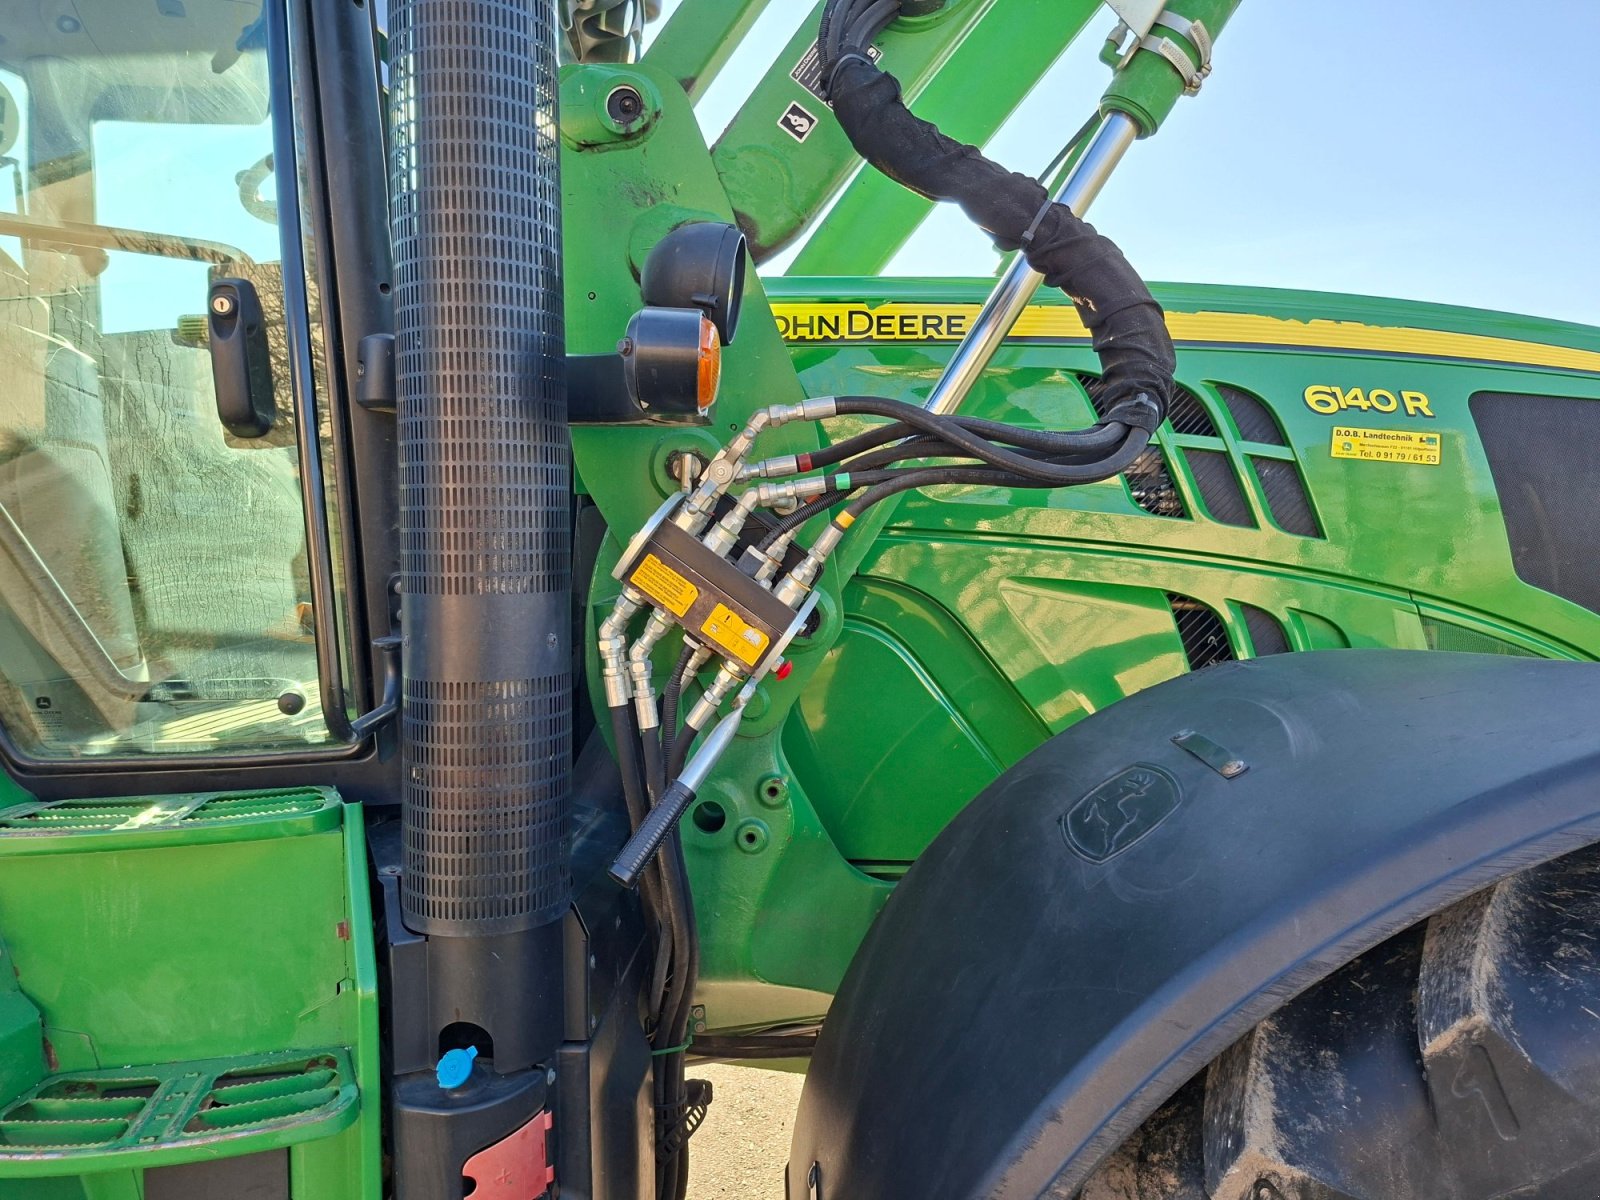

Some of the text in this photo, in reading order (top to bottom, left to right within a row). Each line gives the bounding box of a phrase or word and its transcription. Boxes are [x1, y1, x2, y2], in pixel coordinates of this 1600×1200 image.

[774, 310, 966, 336] OHN DEERE
[1303, 384, 1436, 418] 6140 R
[1336, 429, 1413, 442] D.O.B. Landtechnik
[1360, 449, 1374, 458] Tel.
[1376, 451, 1382, 459] 0
[1383, 452, 1393, 460] 91
[1396, 452, 1406, 461] 79
[1413, 454, 1423, 462] 61
[1426, 454, 1437, 463] 53
